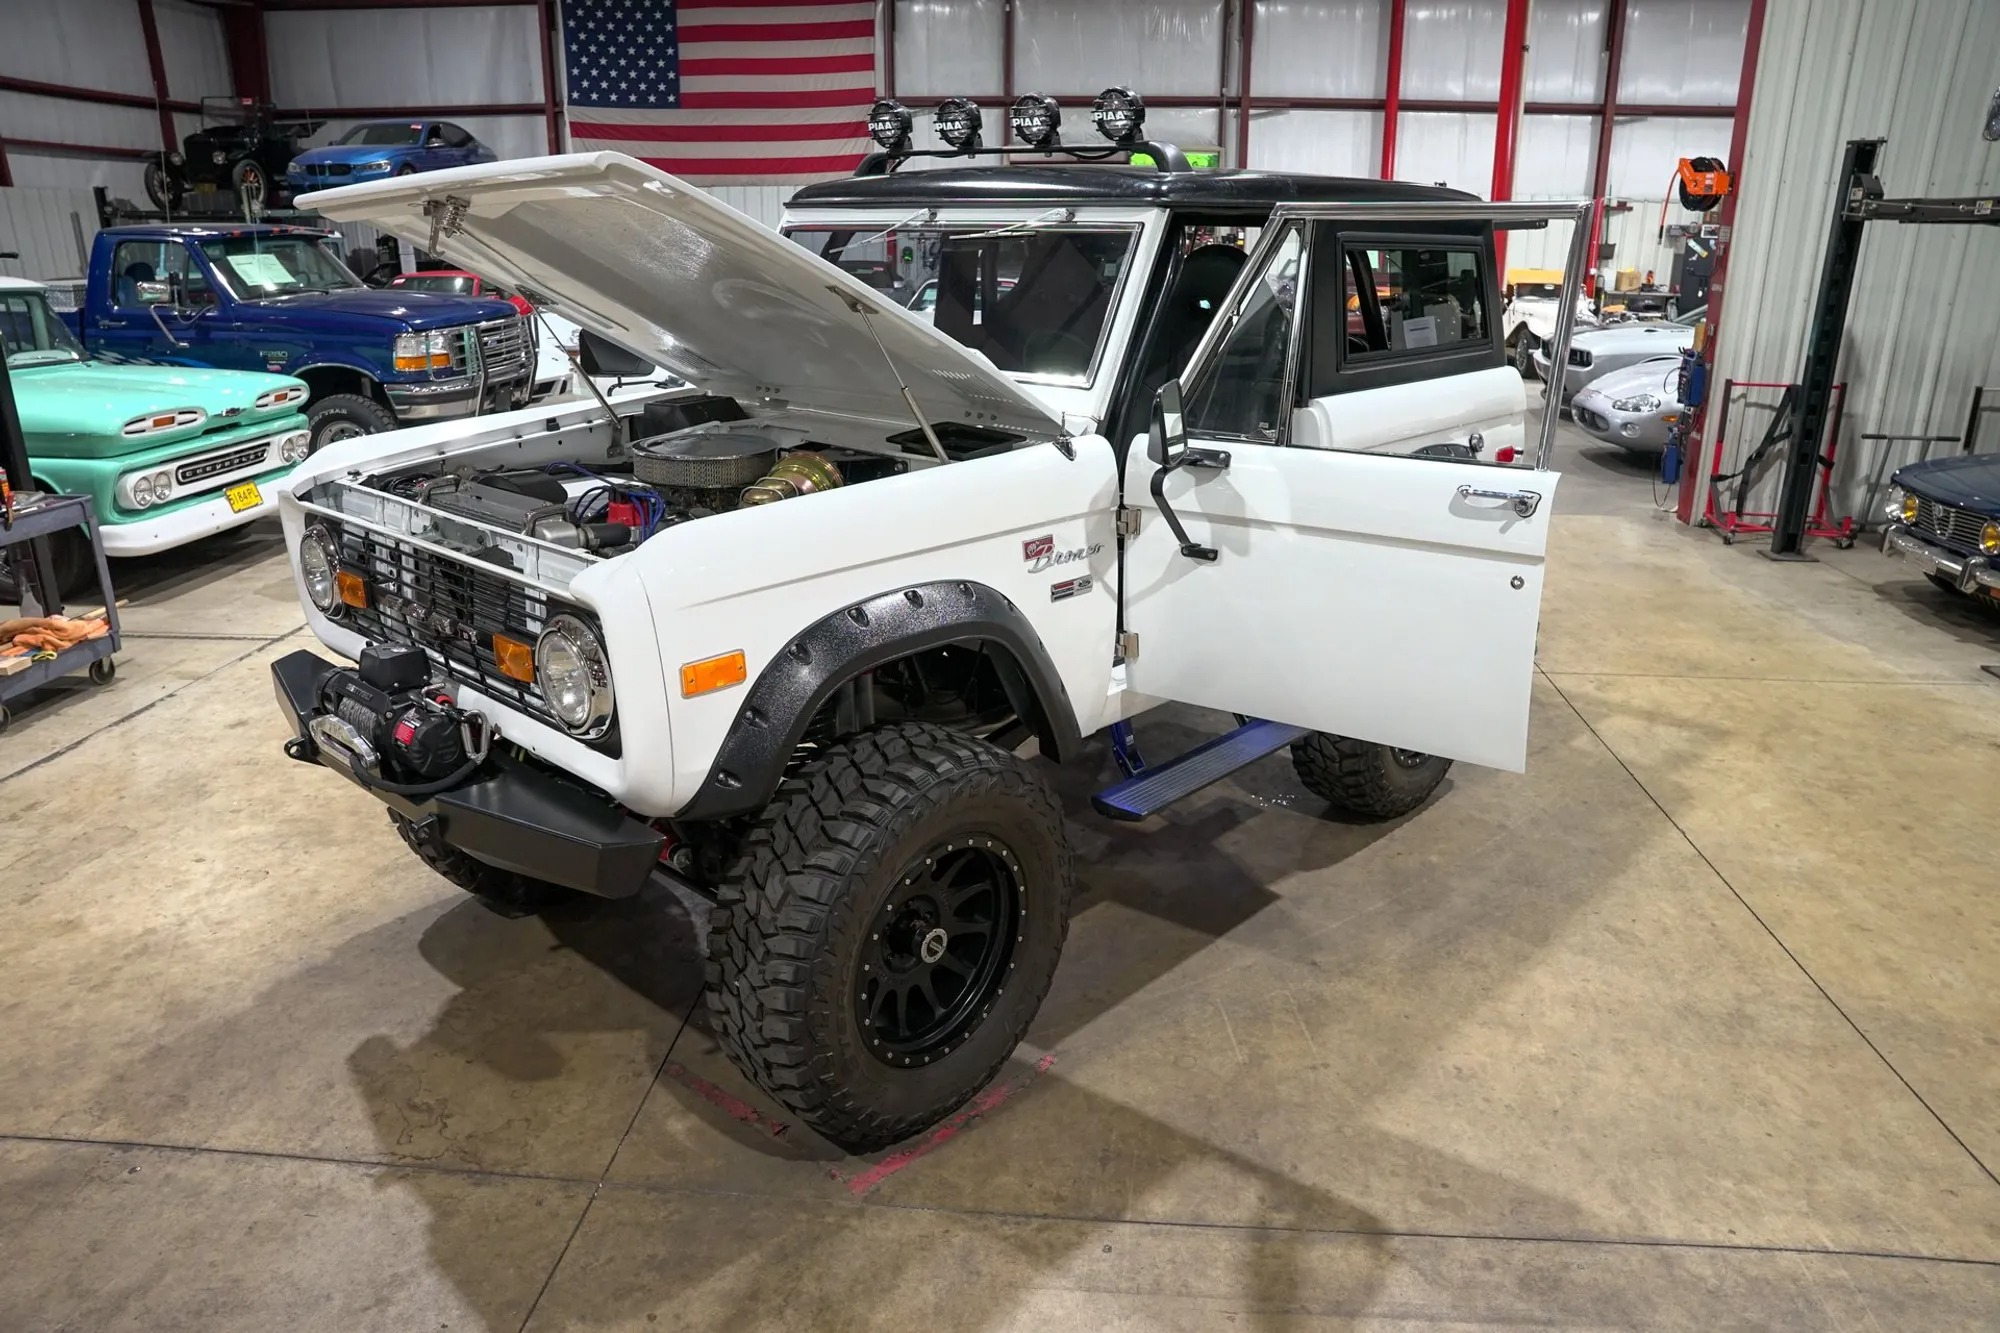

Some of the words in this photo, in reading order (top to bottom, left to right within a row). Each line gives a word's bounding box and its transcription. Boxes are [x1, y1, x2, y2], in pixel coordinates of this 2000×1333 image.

[1094, 111, 1125, 121] PIAA
[868, 122, 893, 131] PIAA
[935, 122, 963, 131] PIAA
[1012, 117, 1042, 127] PIAA
[185, 451, 264, 477] CHEVROLET
